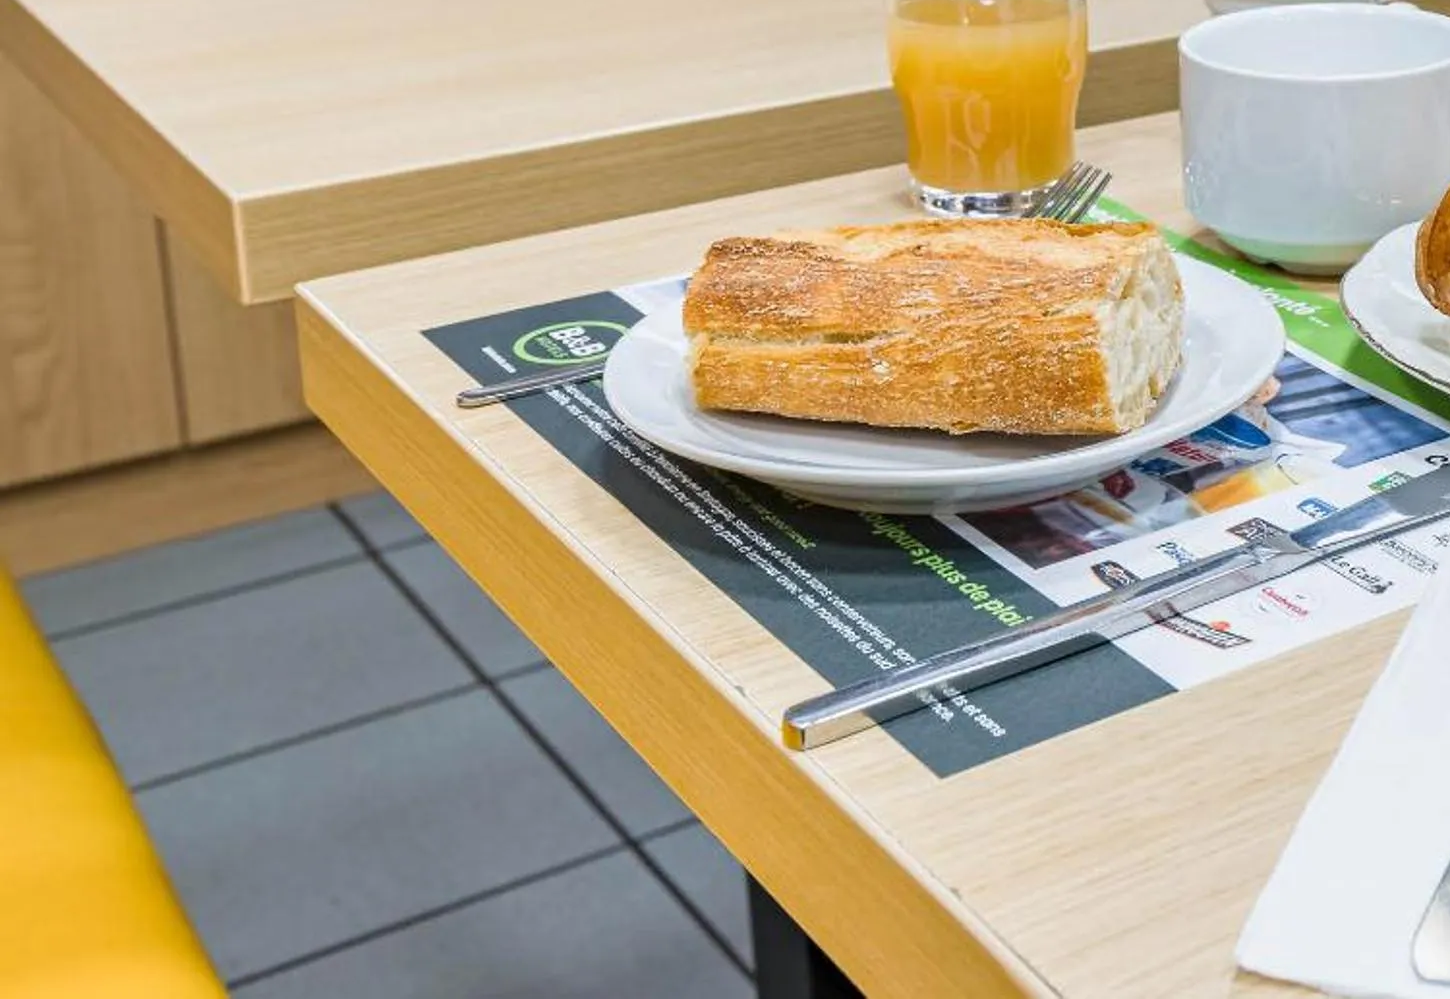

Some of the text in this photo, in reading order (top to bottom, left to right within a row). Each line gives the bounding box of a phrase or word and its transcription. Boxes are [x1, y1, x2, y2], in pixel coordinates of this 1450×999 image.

[550, 326, 606, 357] B&B
[911, 554, 967, 585] plus
[958, 581, 991, 602] de
[973, 597, 1034, 628] plai
